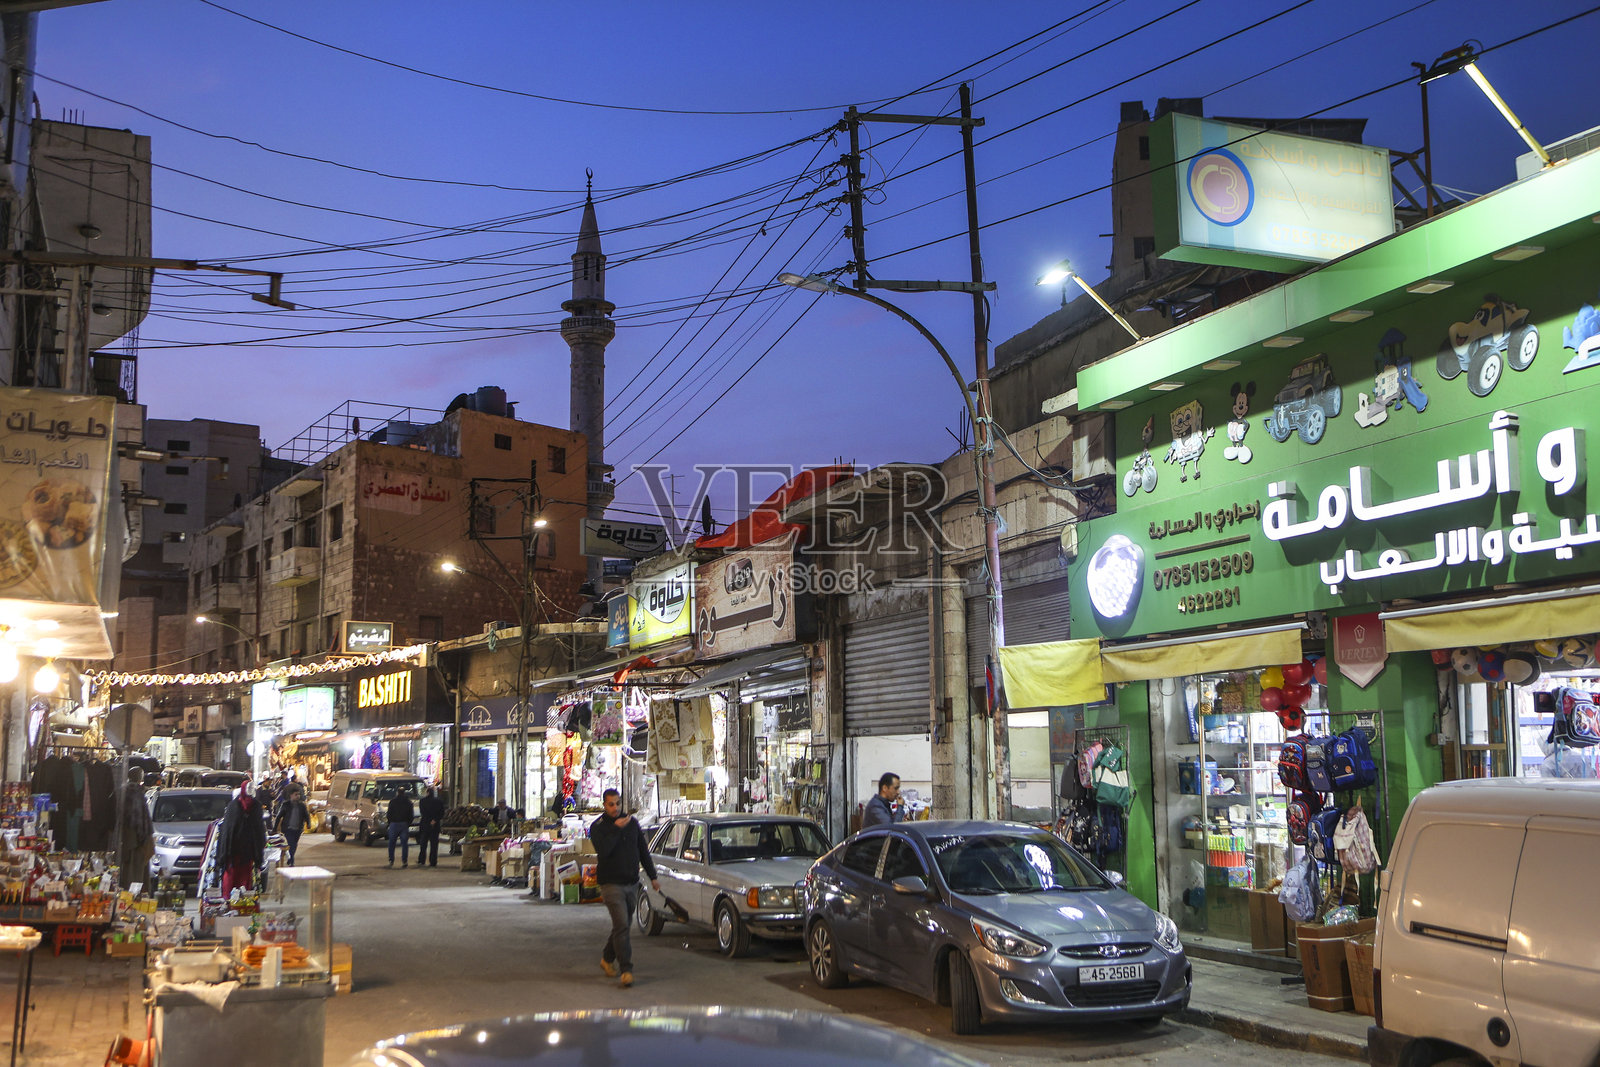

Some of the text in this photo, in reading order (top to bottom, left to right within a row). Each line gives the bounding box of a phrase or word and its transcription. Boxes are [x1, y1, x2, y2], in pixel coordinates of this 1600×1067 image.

[1325, 153, 1383, 182] باسل
[6, 411, 108, 443] حلويات
[37, 449, 89, 477] الطعم
[1153, 550, 1254, 591] 0785152509
[1177, 585, 1241, 615] 4622231
[1341, 646, 1379, 662] VERTEX
[358, 670, 412, 709] BASHITI
[1092, 965, 1141, 981] 45-25681
